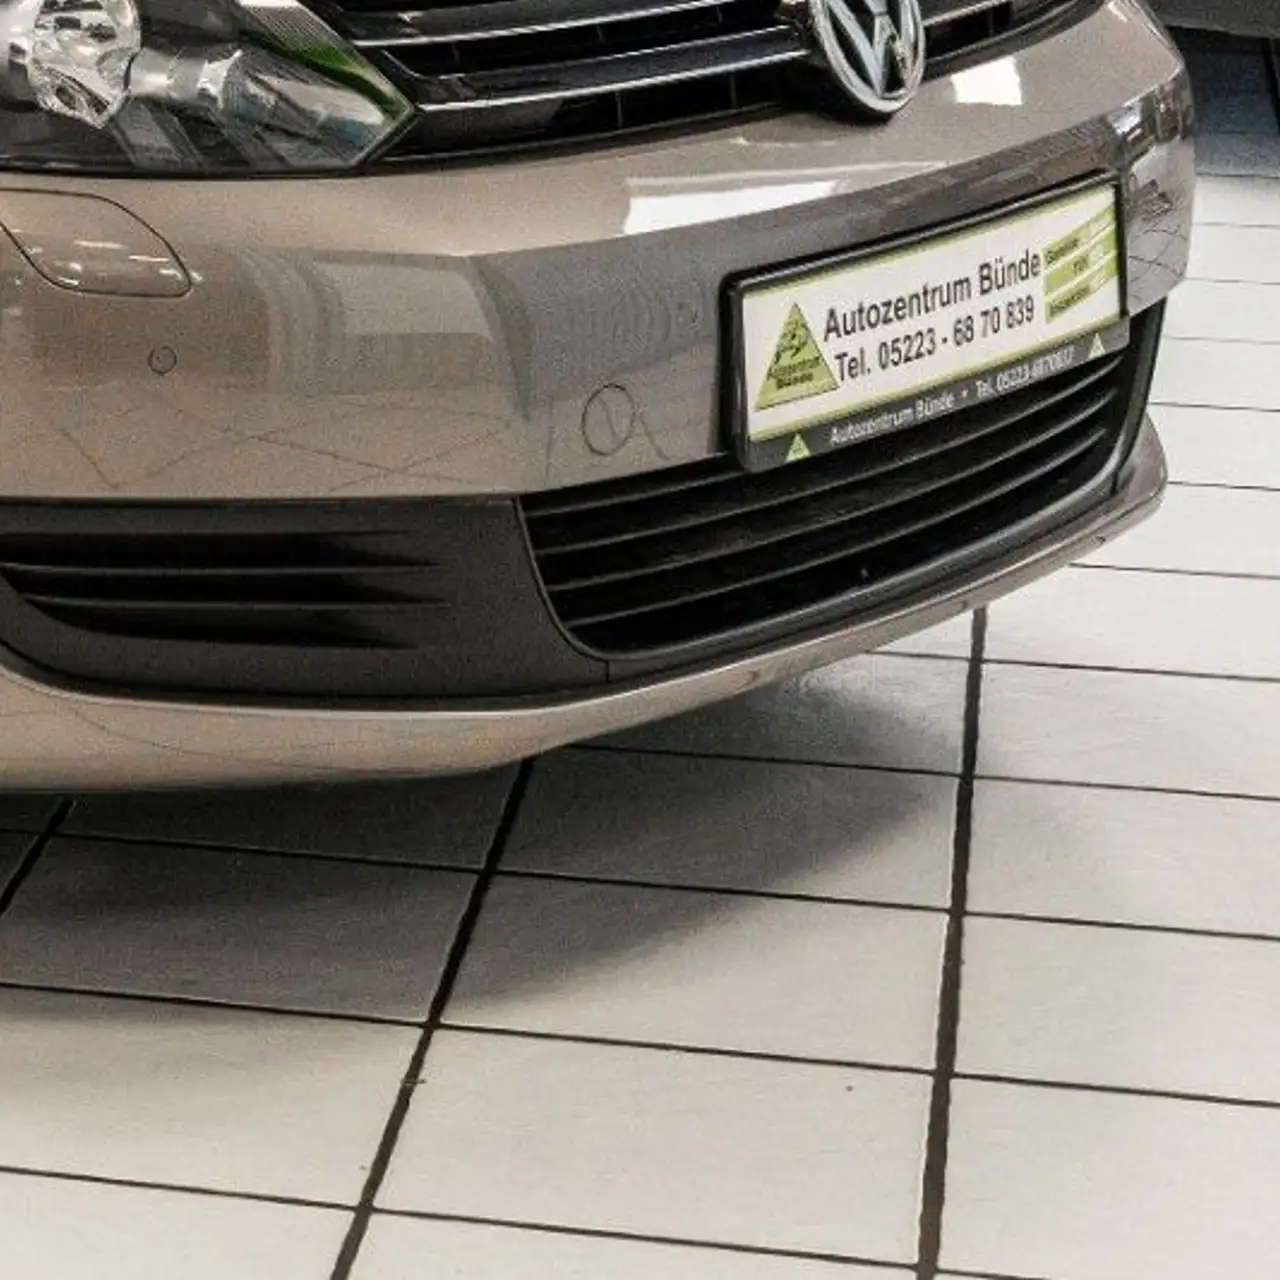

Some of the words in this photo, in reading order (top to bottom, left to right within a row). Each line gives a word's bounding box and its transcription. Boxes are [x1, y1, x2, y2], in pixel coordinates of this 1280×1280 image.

[823, 276, 973, 343] Autozentrum
[977, 248, 1041, 296] Bünde
[834, 346, 872, 382] Tel.
[878, 326, 937, 371] 05223
[952, 314, 976, 348] 68
[980, 305, 1001, 338] 70
[1006, 294, 1035, 329] 839
